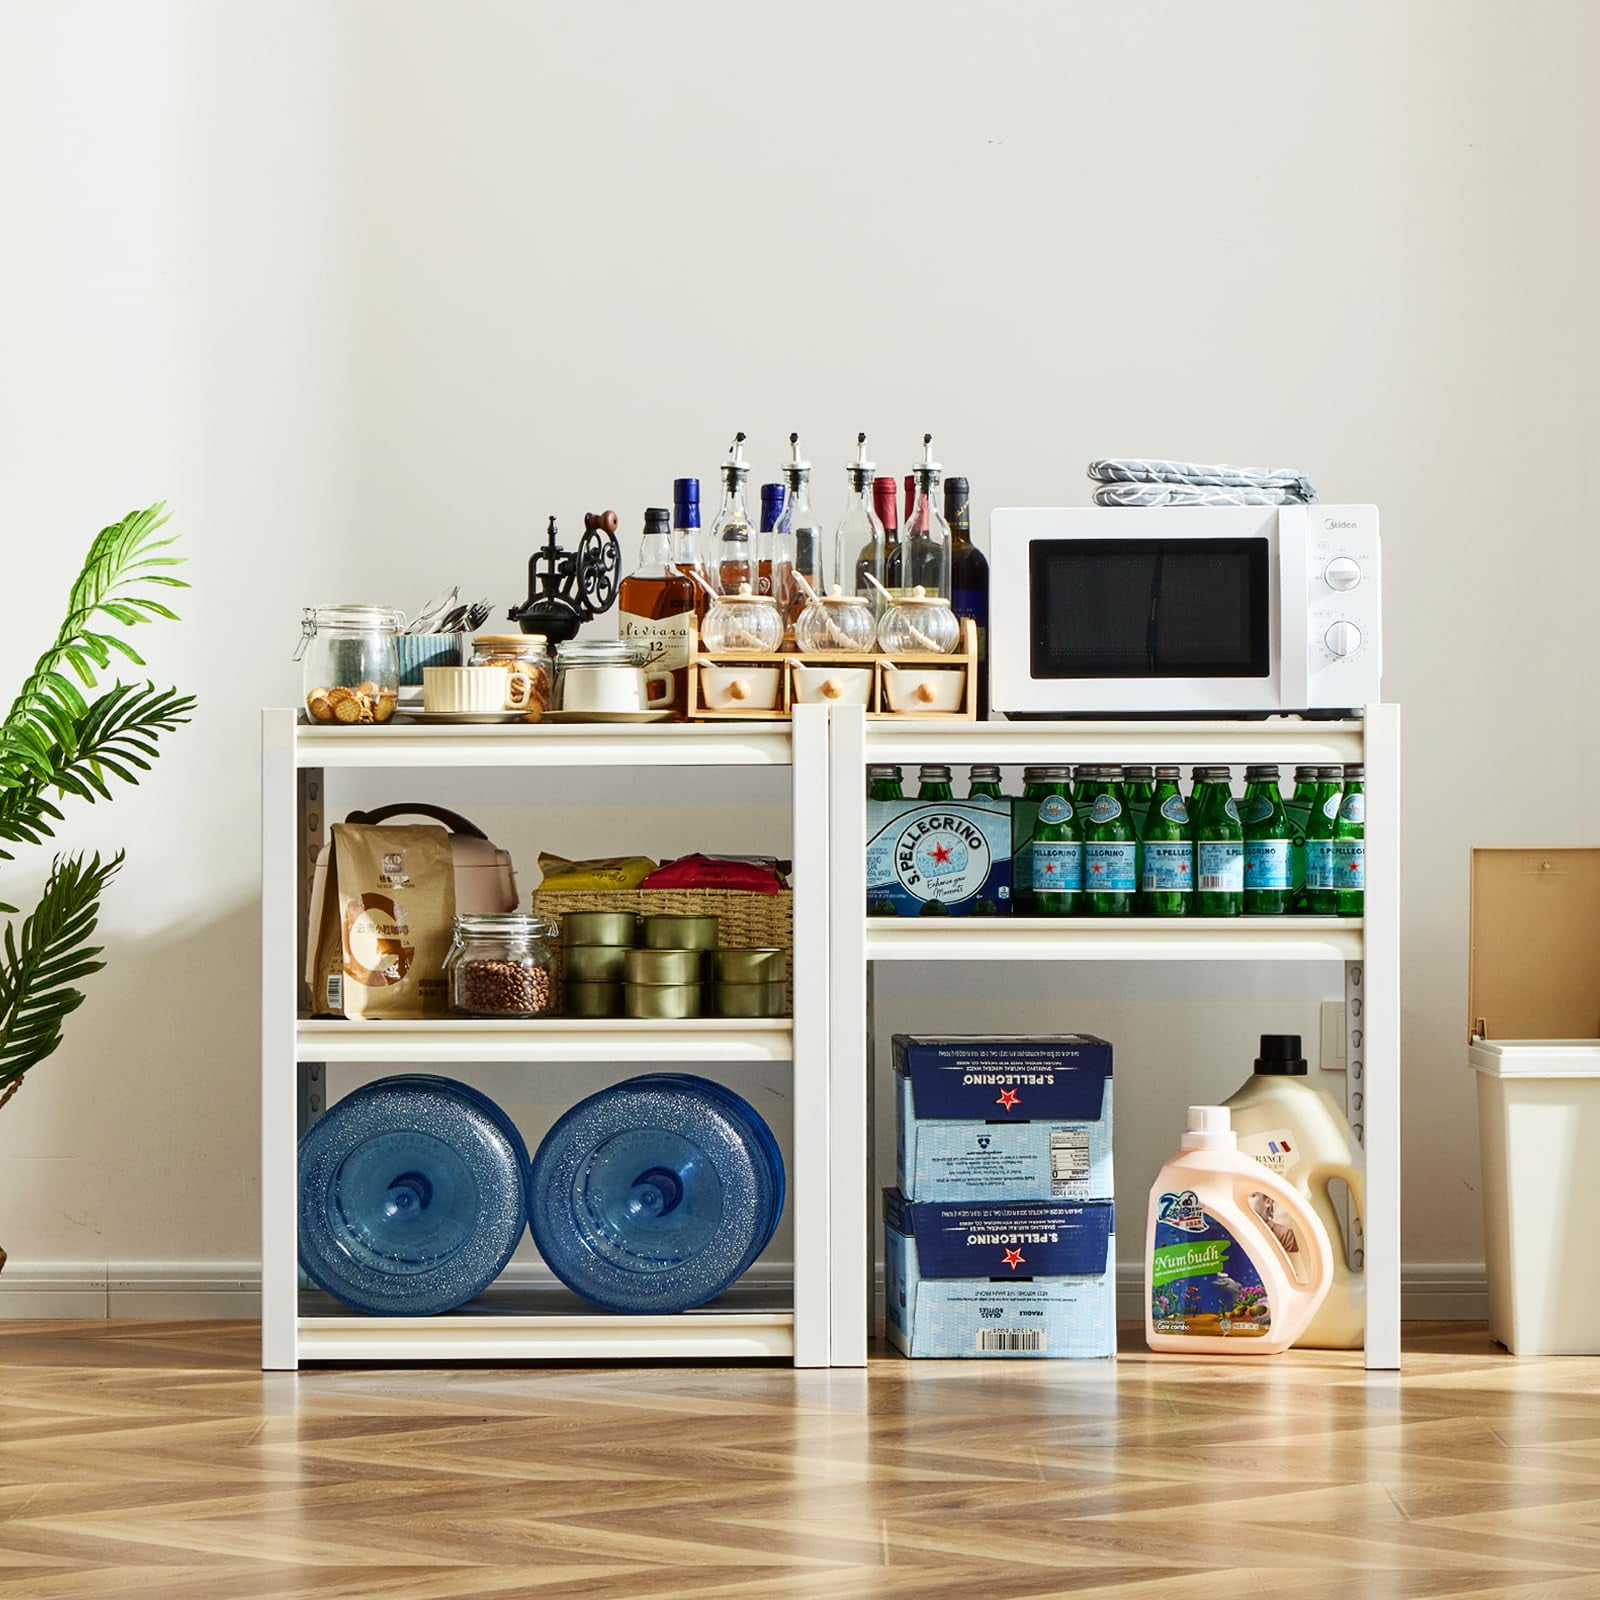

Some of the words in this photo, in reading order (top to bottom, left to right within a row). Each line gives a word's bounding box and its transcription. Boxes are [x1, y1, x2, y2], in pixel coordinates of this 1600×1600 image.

[1323, 518, 1357, 530] Midea
[649, 641, 663, 651] 12
[900, 817, 982, 885] S.PELLEGRINO
[964, 1074, 1055, 1085] S.PELLEGRINO
[967, 1232, 1058, 1246] S.PELLEGRINO
[1155, 1245, 1219, 1271] Numbudh
